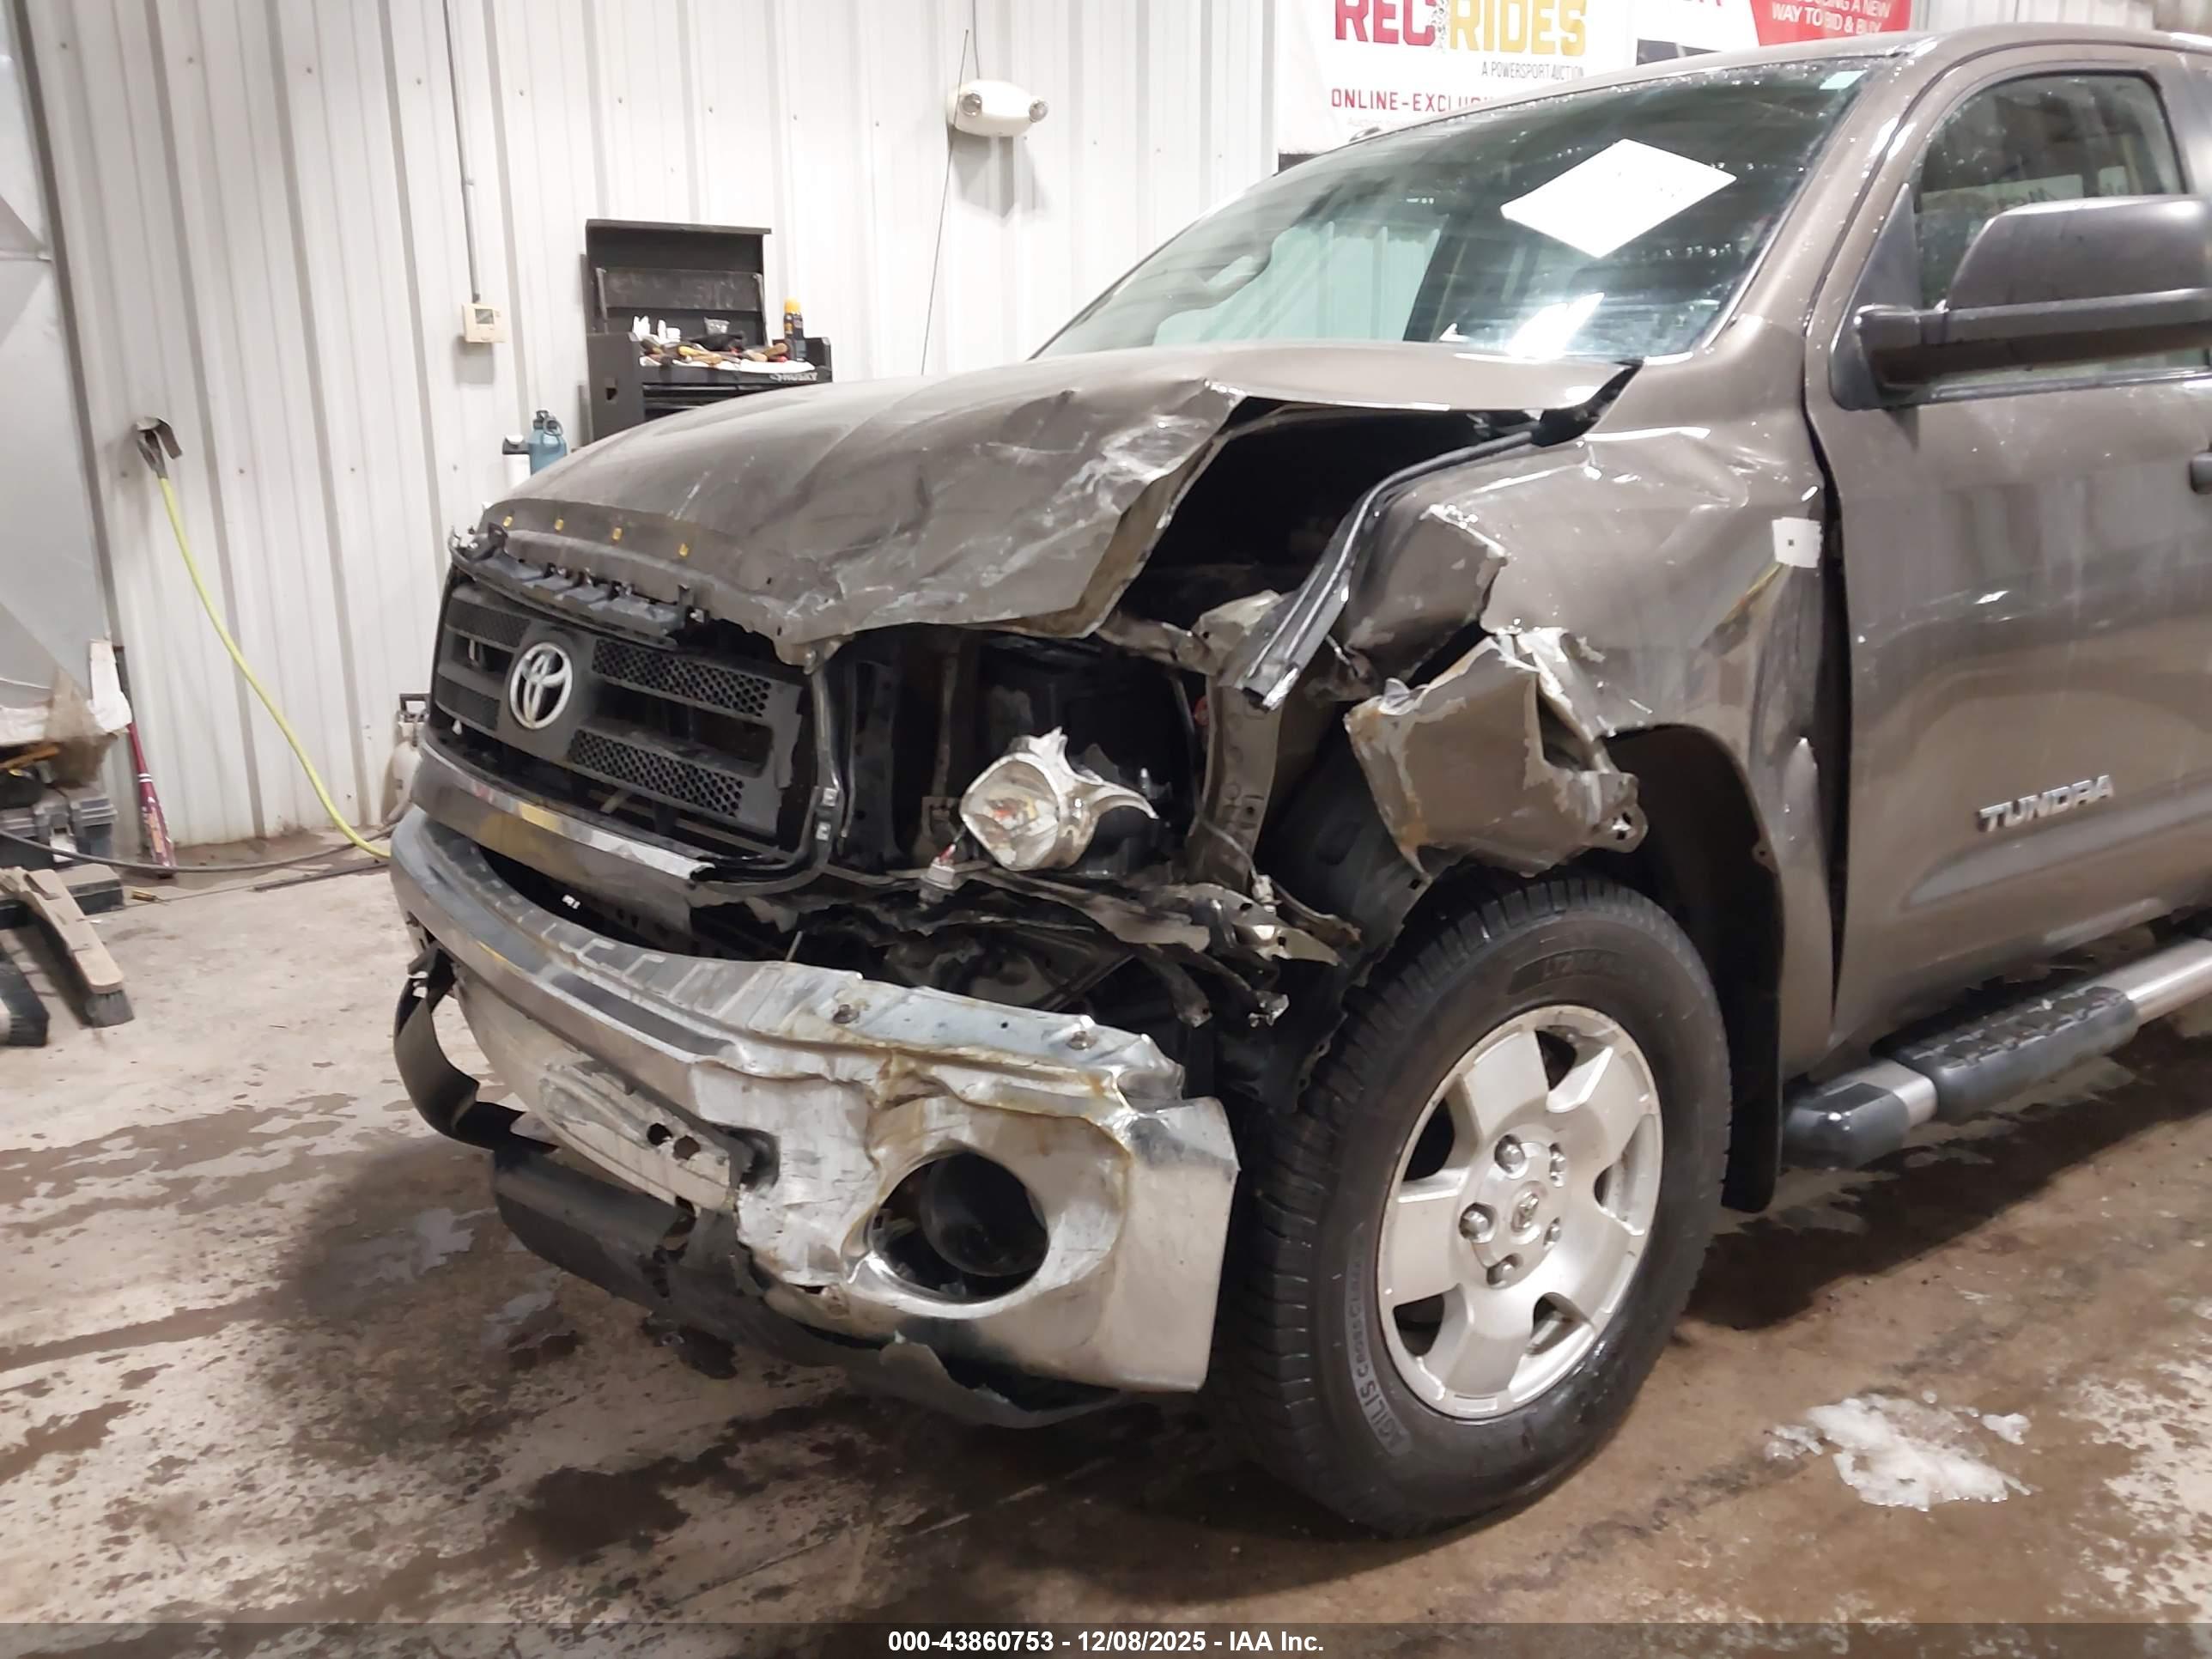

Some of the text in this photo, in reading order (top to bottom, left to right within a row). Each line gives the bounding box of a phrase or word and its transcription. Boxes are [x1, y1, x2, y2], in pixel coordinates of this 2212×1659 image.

[1335, 0, 1587, 57] REC RIDES
[1771, 3, 1803, 23] WAY
[1804, 7, 1823, 27] TO
[1844, 15, 1854, 33] &
[1481, 61, 1584, 80] A POWERSPORT AUCTION
[1978, 775, 2114, 832] TUNDRA
